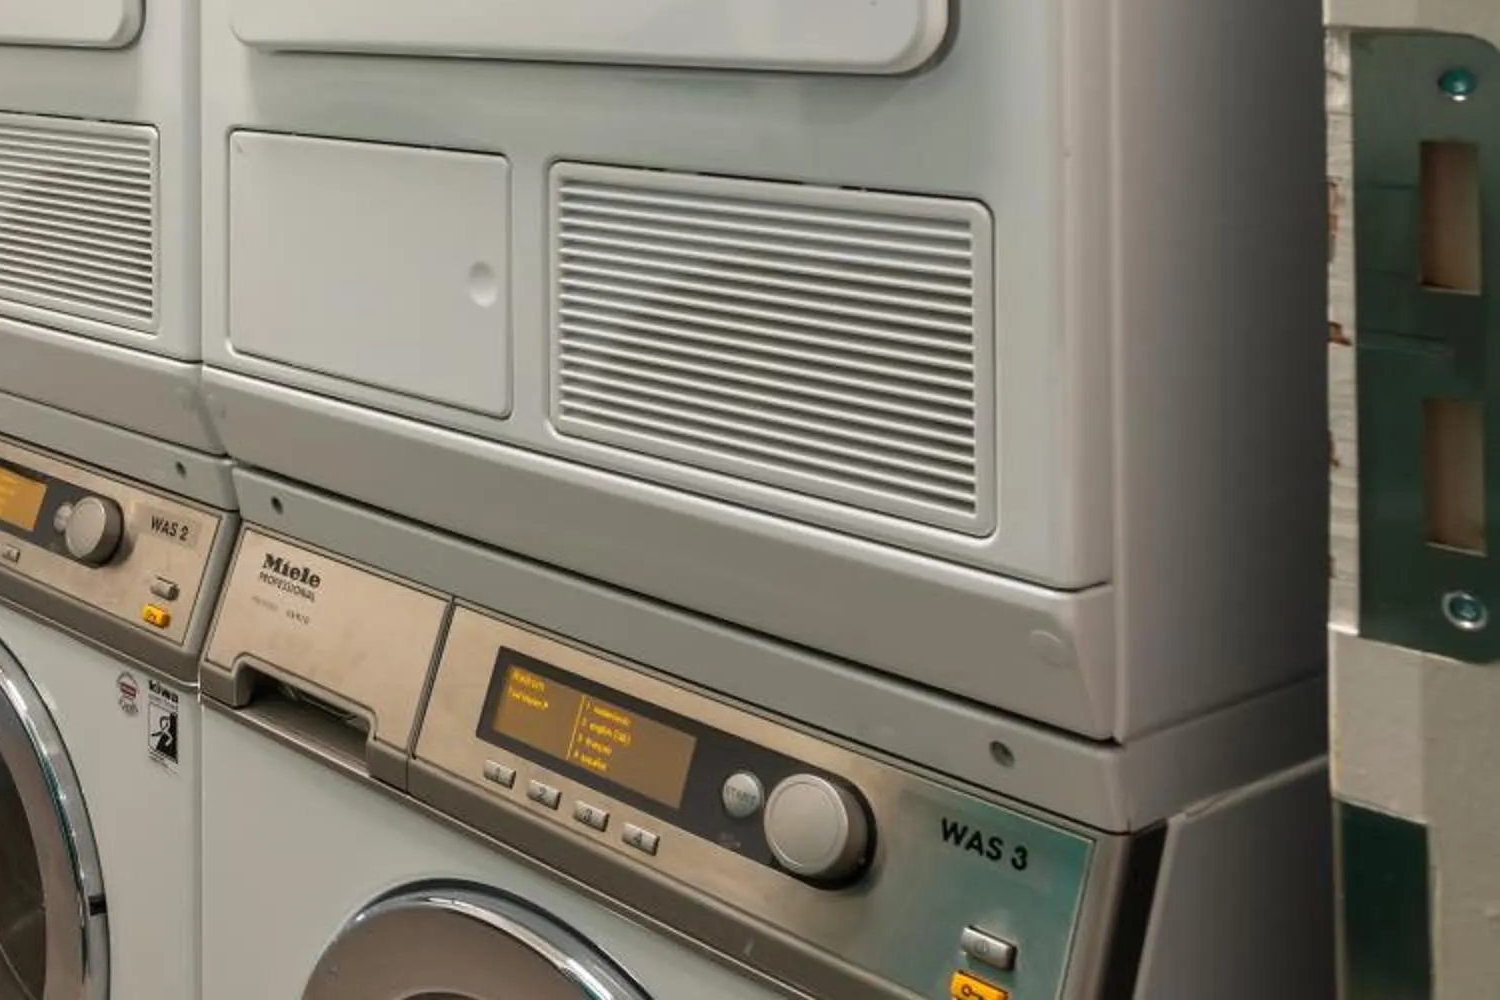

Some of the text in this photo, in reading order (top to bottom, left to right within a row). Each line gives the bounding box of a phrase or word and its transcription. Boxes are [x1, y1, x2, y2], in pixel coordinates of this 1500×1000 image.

[151, 515, 189, 541] WAS 2
[263, 553, 321, 589] Miele
[941, 817, 1028, 871] WAS 3
